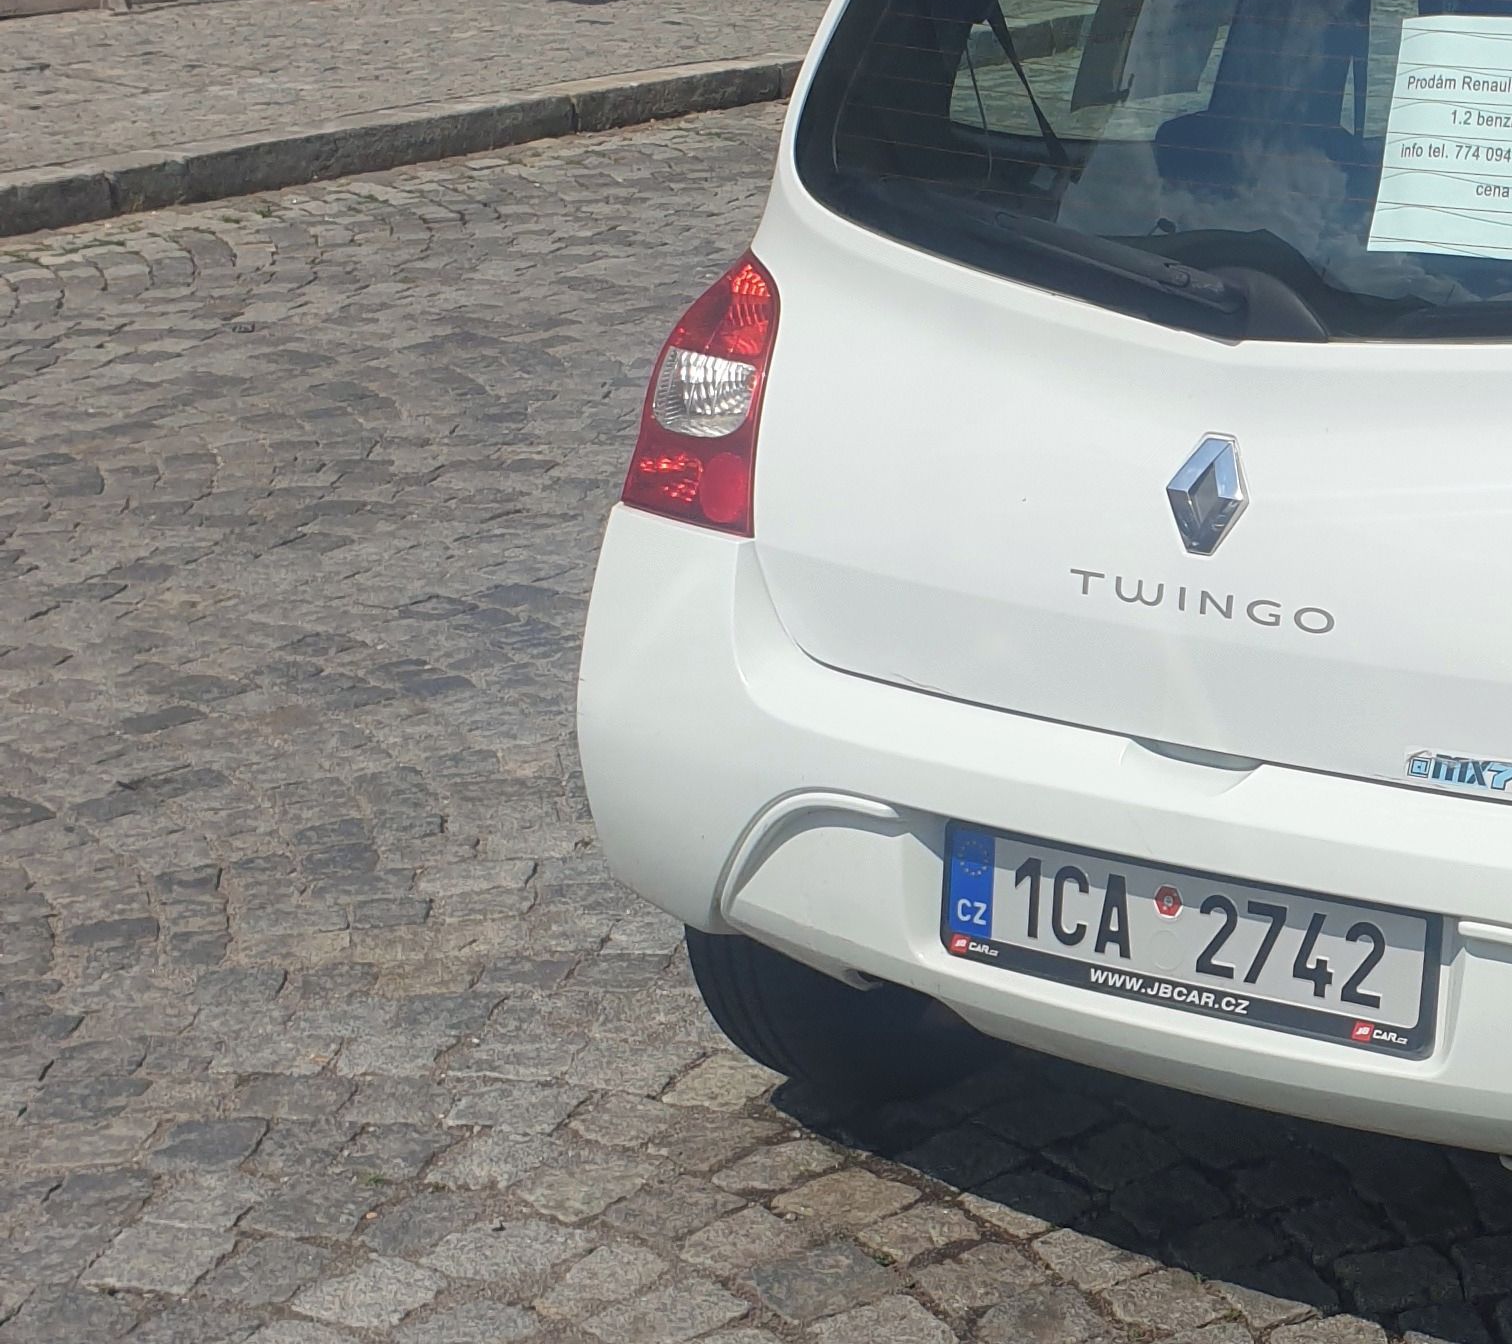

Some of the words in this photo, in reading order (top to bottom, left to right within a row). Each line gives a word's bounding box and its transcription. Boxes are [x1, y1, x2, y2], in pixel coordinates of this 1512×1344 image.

[1407, 74, 1456, 91] Prodám
[1451, 109, 1473, 126] 1.2
[1400, 142, 1424, 159] info
[1428, 143, 1449, 160] tel.
[1455, 144, 1481, 161] 774
[1485, 146, 1512, 163] 094
[1475, 183, 1511, 199] cena
[1069, 567, 1337, 635] TWINGO
[956, 896, 989, 927] CZ
[1013, 856, 1133, 961] 1CA
[1194, 893, 1387, 1010] 2742
[1089, 967, 1251, 1015] WWW.JBCAR.CZ
